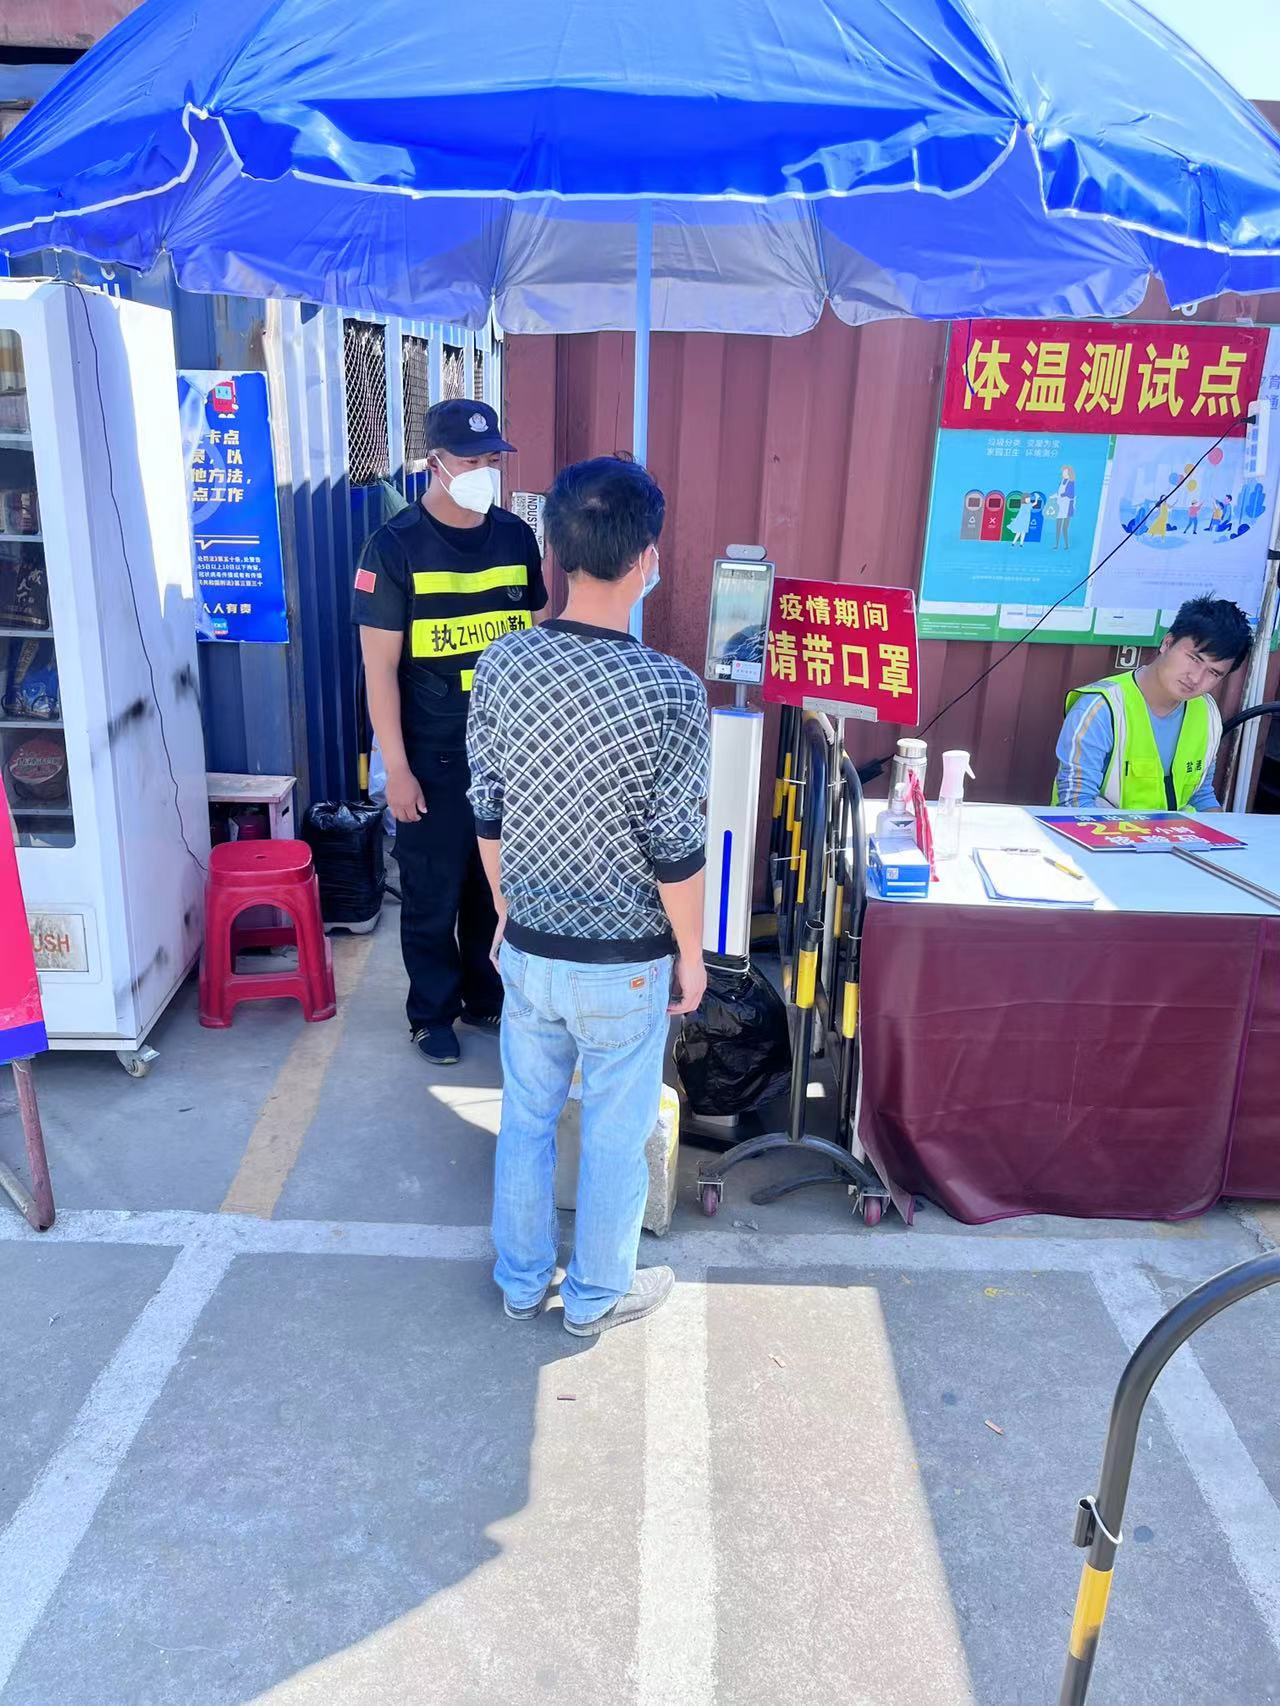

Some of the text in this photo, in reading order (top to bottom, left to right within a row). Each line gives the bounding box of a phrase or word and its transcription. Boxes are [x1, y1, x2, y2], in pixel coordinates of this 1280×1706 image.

[962, 339, 1247, 417] 体温测试点
[192, 488, 244, 503] 点工作
[780, 593, 888, 632] 疫情期间
[768, 630, 912, 699] 请带口罩
[31, 933, 70, 953] USH
